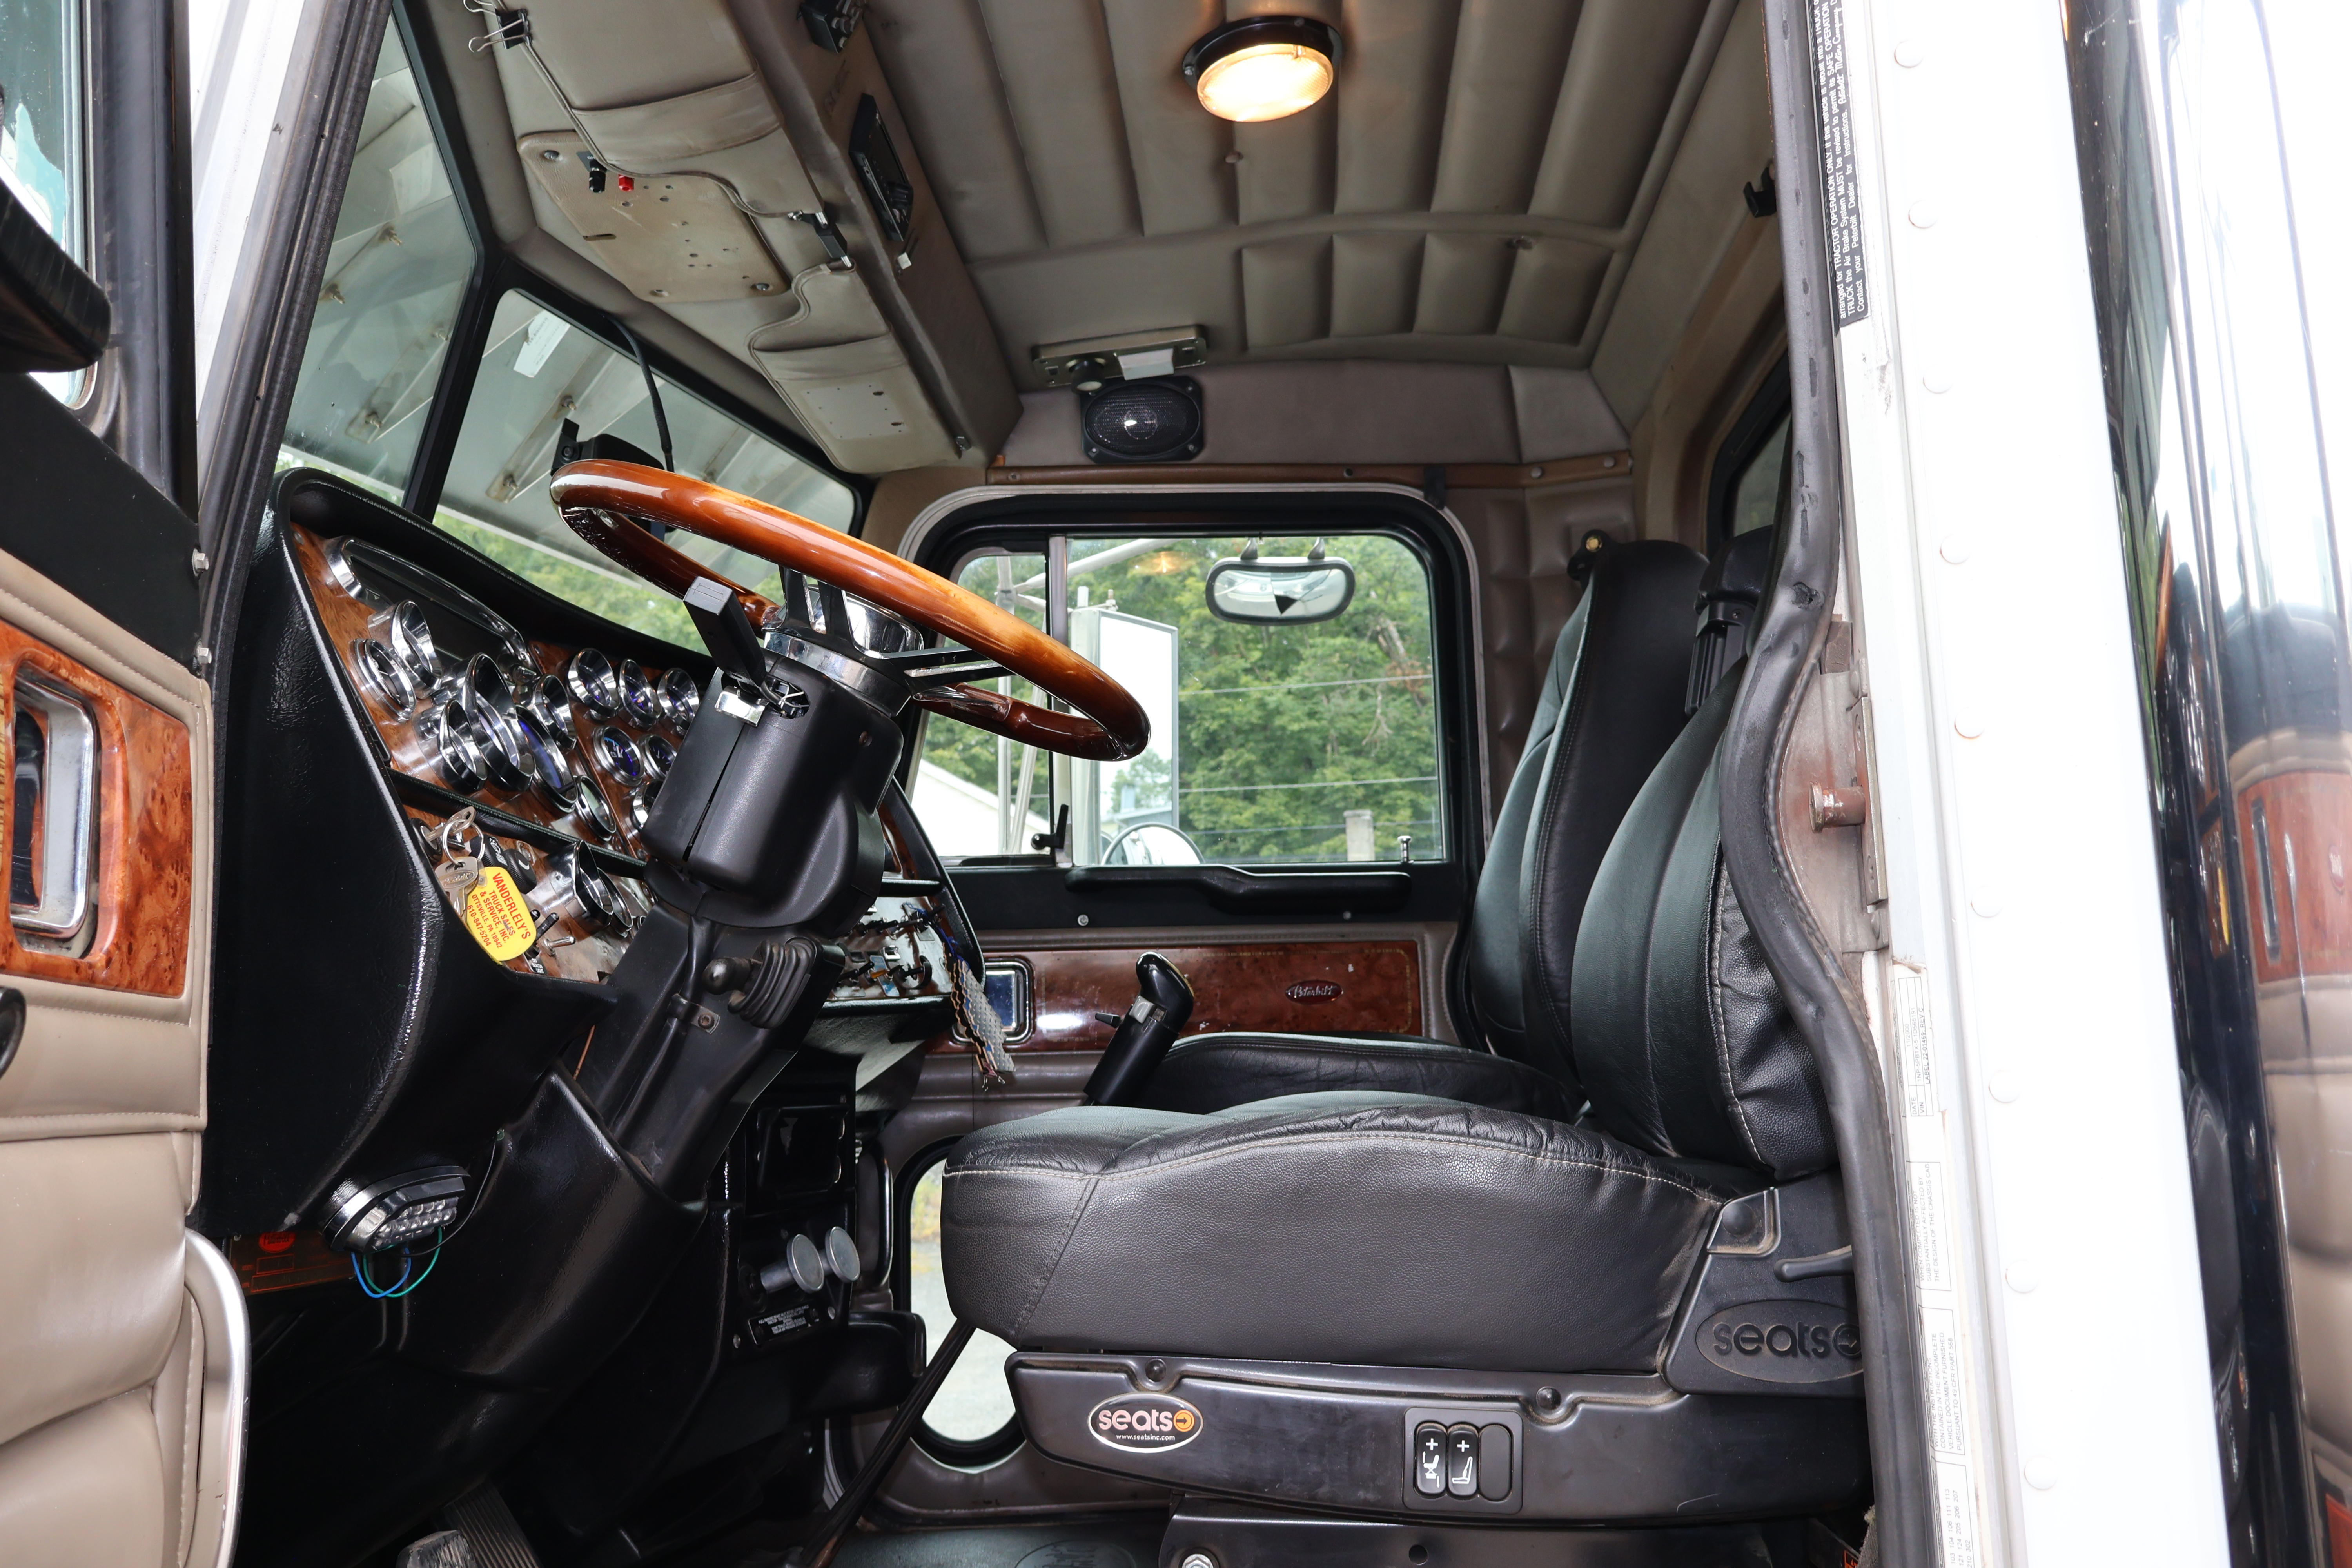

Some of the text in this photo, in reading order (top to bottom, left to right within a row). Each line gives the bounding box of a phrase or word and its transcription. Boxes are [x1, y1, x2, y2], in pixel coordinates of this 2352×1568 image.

[1821, 1, 1832, 51] OPERATION
[1832, 7, 1845, 44] Company
[1826, 52, 1835, 76] SAFE
[1834, 44, 1843, 73] Motors
[1829, 89, 1839, 114] permit
[1837, 73, 1847, 104] Peterbilt
[1832, 116, 1838, 125] to
[1841, 109, 1851, 156] Instructions.
[1832, 126, 1841, 154] revised
[1835, 156, 1842, 169] be
[1828, 175, 1838, 225] OPERATION
[1836, 171, 1845, 196] MUST
[1847, 182, 1855, 208] Dealer
[1840, 197, 1849, 227] System
[1842, 229, 1850, 253] Brake
[1849, 214, 1858, 248] Peterbilt
[1831, 227, 1841, 270] TRACTOR
[1854, 255, 1863, 273] your
[1837, 283, 1846, 319] arranged
[1846, 284, 1855, 316] TRUCK
[1855, 279, 1864, 312] Contact
[471, 894, 488, 924] OTTSVILLE,
[491, 932, 502, 948] 18942
[483, 897, 501, 928] SERVICE,
[499, 928, 510, 943] INC.
[489, 891, 515, 936] TRUCK SALES
[492, 873, 530, 939] VANDERLELY'S
[466, 905, 491, 946] 610-847-5204
[1918, 1176, 1923, 1185] BY
[1930, 1228, 1936, 1237] OF
[1922, 1226, 1931, 1281] SUBSTANTIALLY
[1713, 1321, 1830, 1359] seats
[1931, 1334, 1939, 1379] INCOMPLETE
[1927, 1357, 1935, 1410] INSTRUCTIONS
[1942, 1376, 1951, 1416] DOCUMENT
[1953, 1399, 1958, 1408] TO
[1098, 1409, 1173, 1432] seats
[1937, 1406, 1945, 1448] CONTAINED
